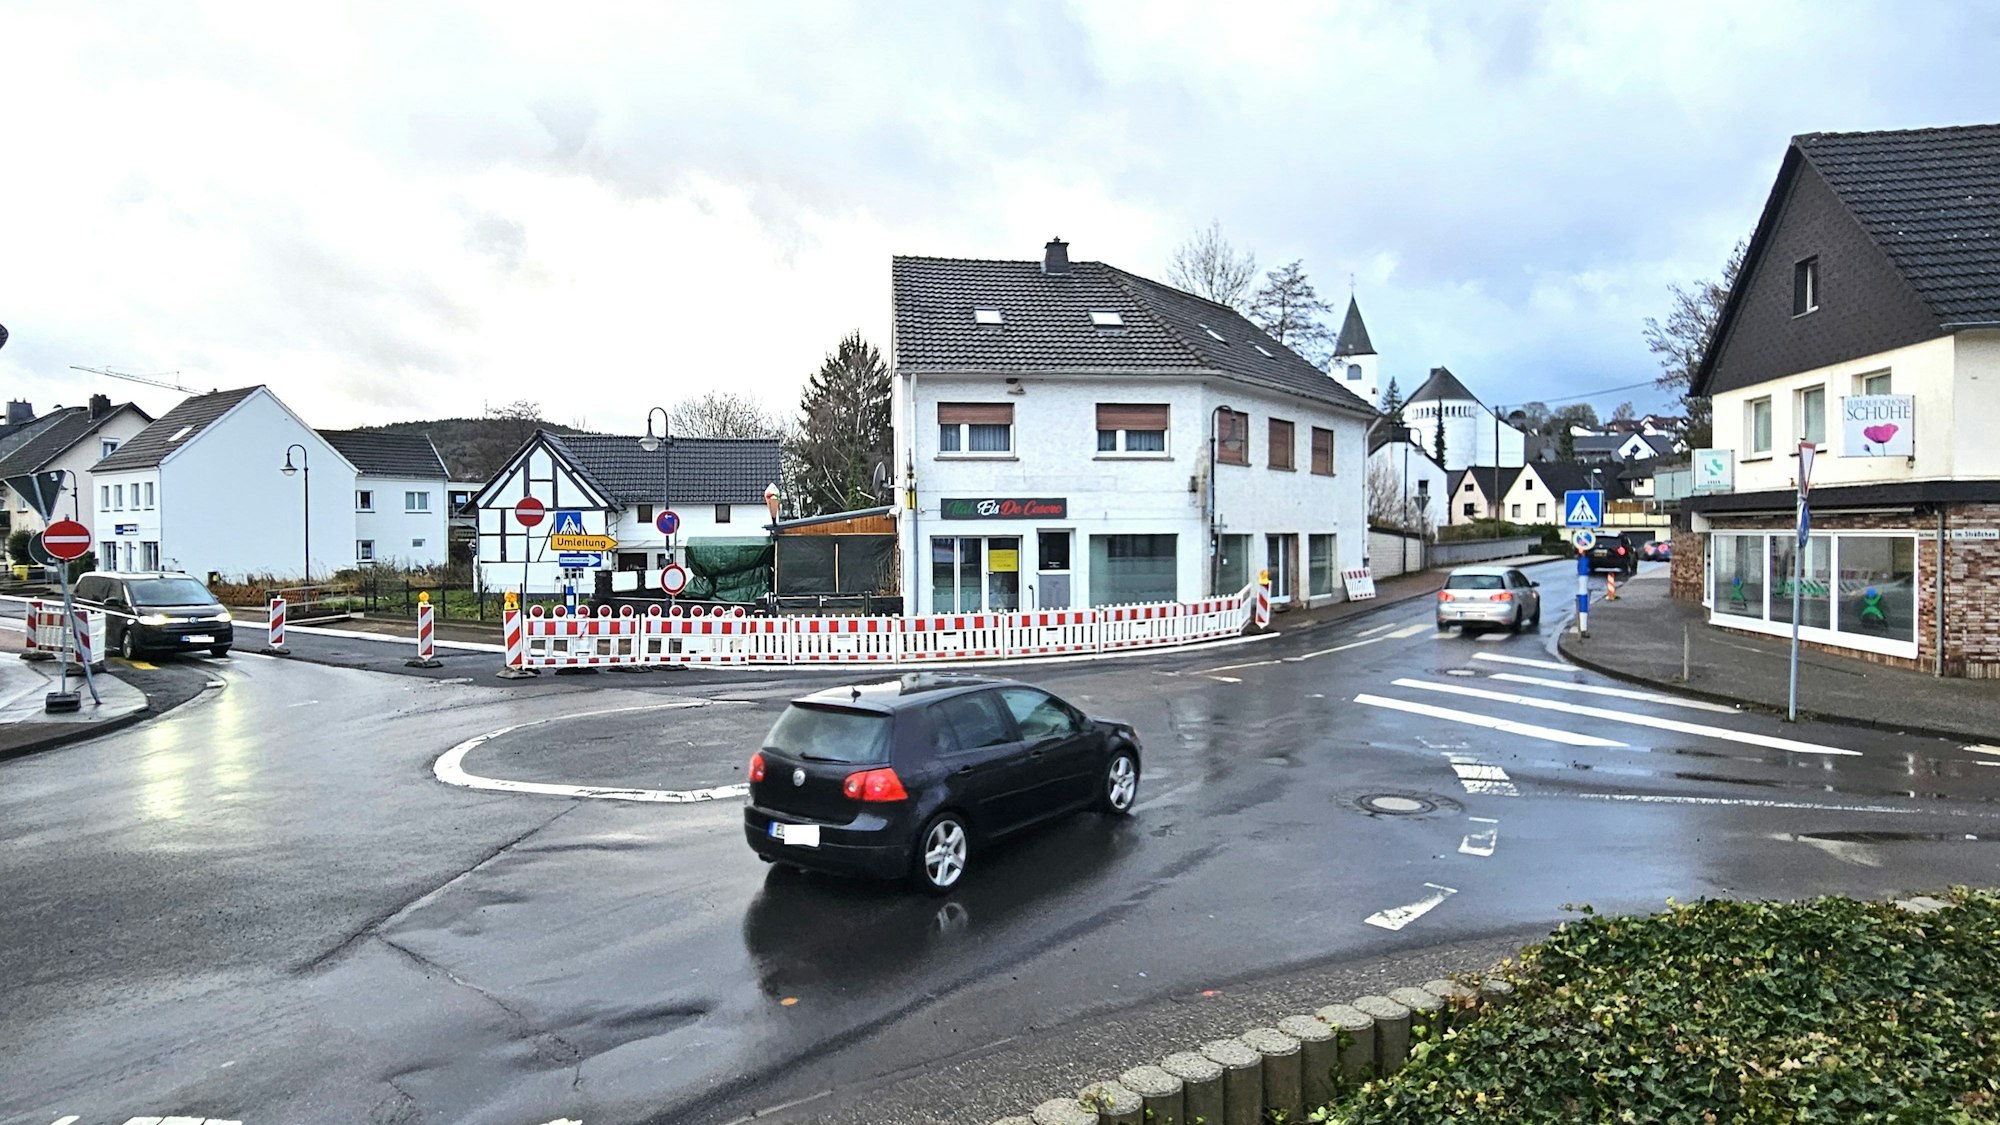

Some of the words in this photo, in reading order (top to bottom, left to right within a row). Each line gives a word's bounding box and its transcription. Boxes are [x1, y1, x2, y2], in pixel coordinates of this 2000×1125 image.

[1846, 406, 1911, 421] SCHUHE
[977, 499, 1000, 516] Eis
[557, 537, 607, 549] Umleitung
